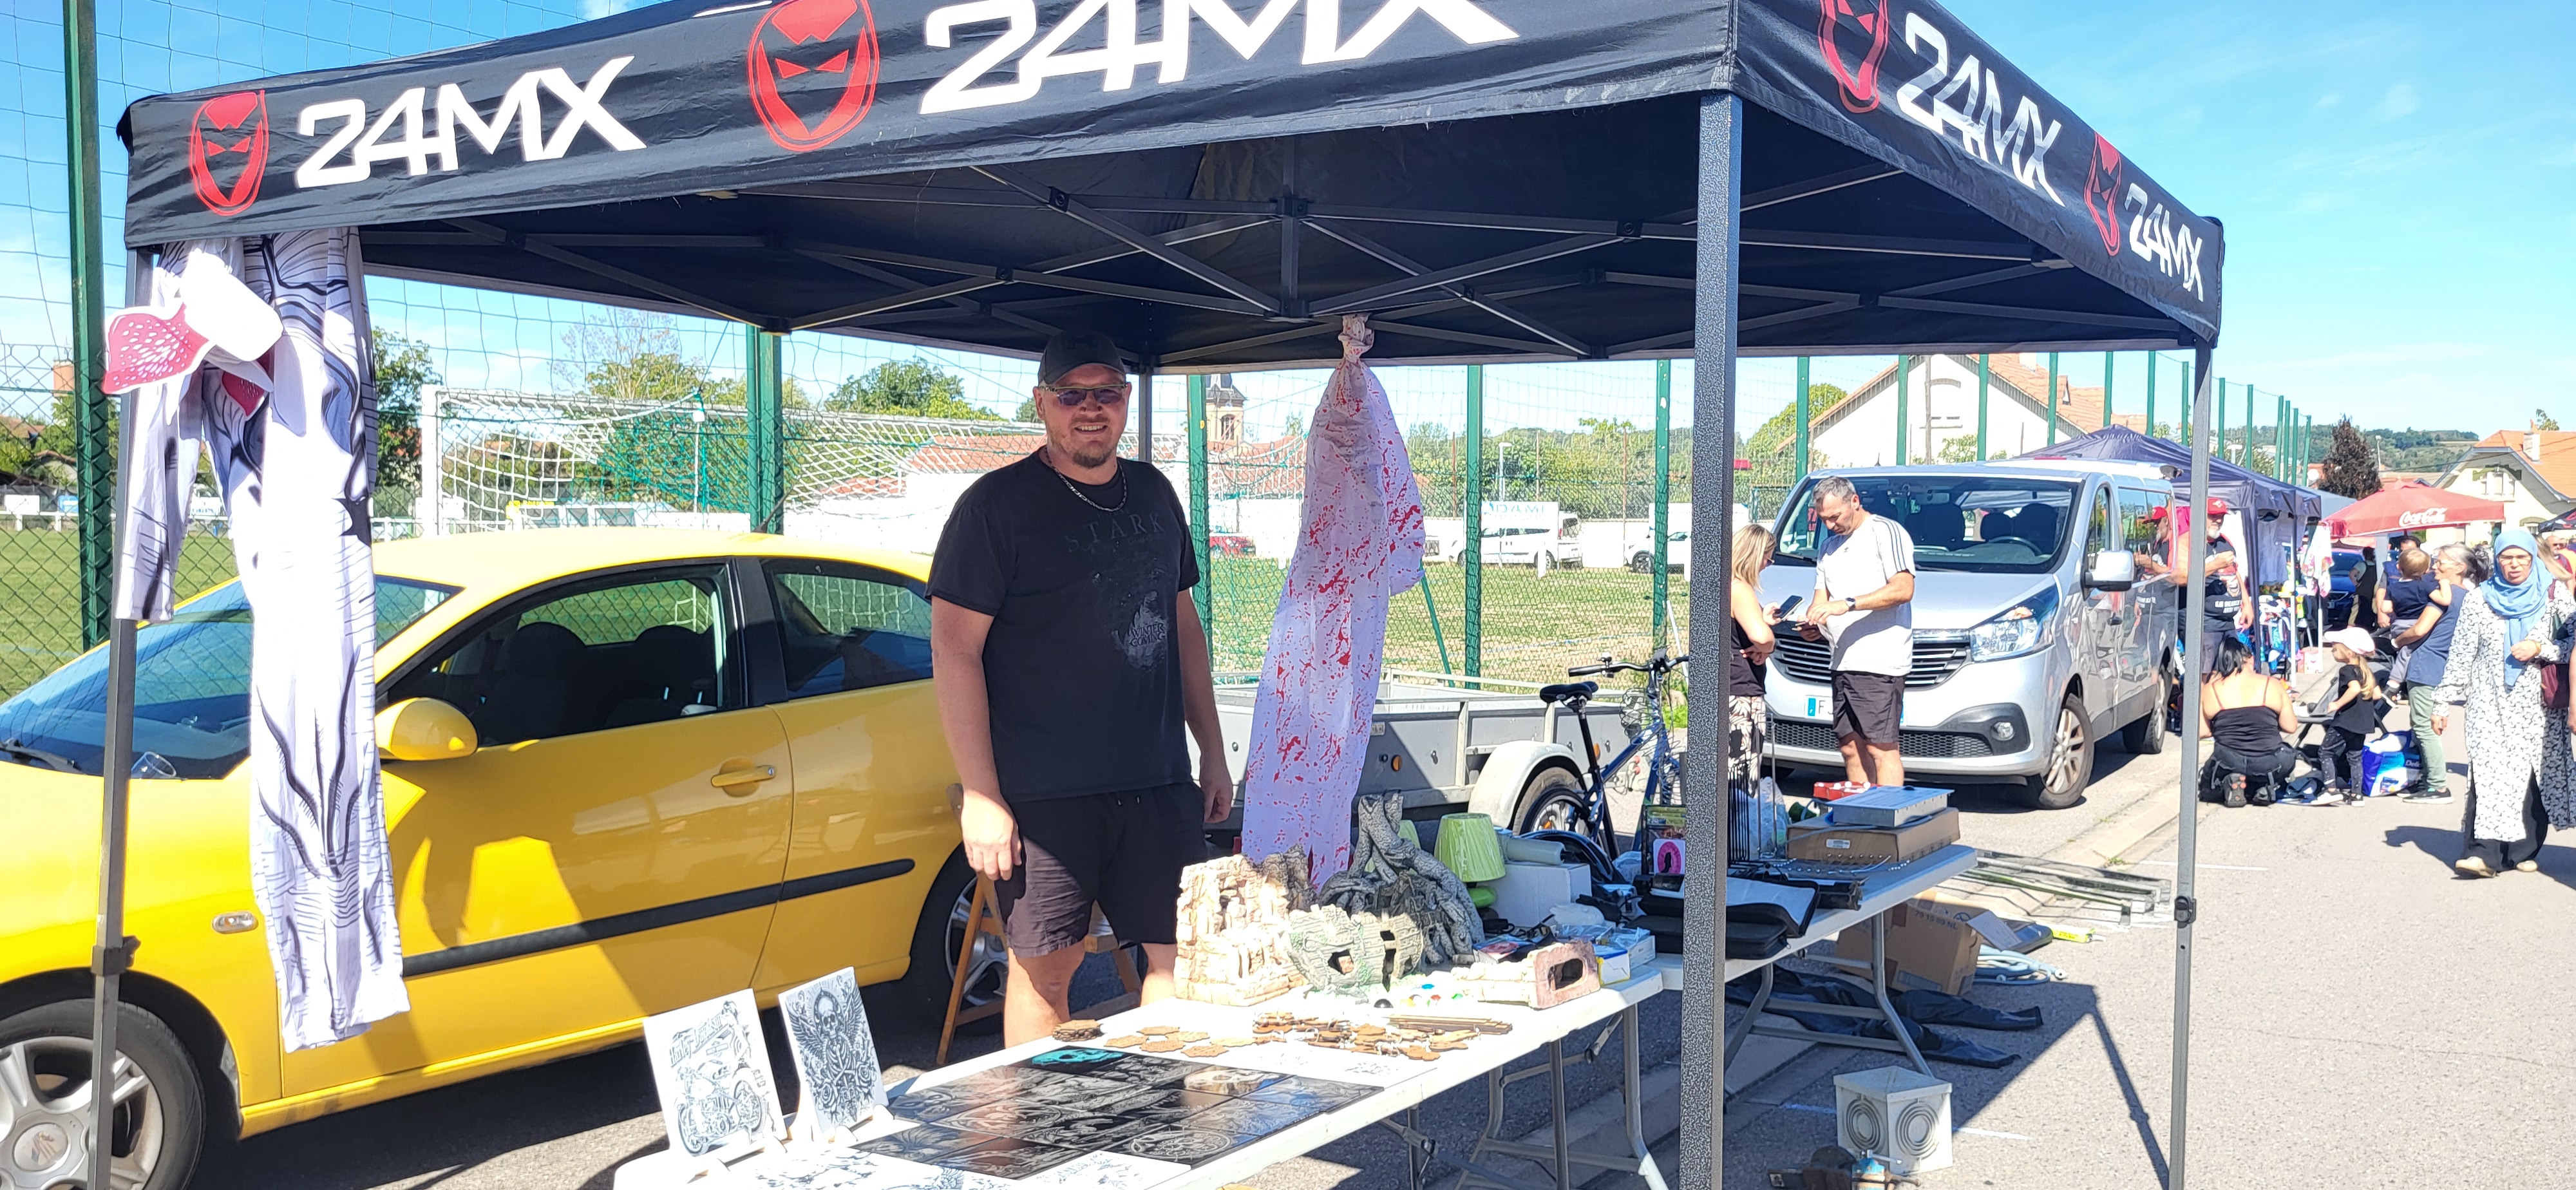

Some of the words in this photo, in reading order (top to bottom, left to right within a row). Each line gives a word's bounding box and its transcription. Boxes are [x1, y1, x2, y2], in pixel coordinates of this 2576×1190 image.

[296, 55, 647, 188] 24MX
[1896, 12, 2065, 207] 24MX
[2125, 183, 2204, 302] 24MX
[1065, 514, 1164, 552] STARK
[1130, 622, 1164, 638] WINTER
[1130, 632, 1165, 647] COMING
